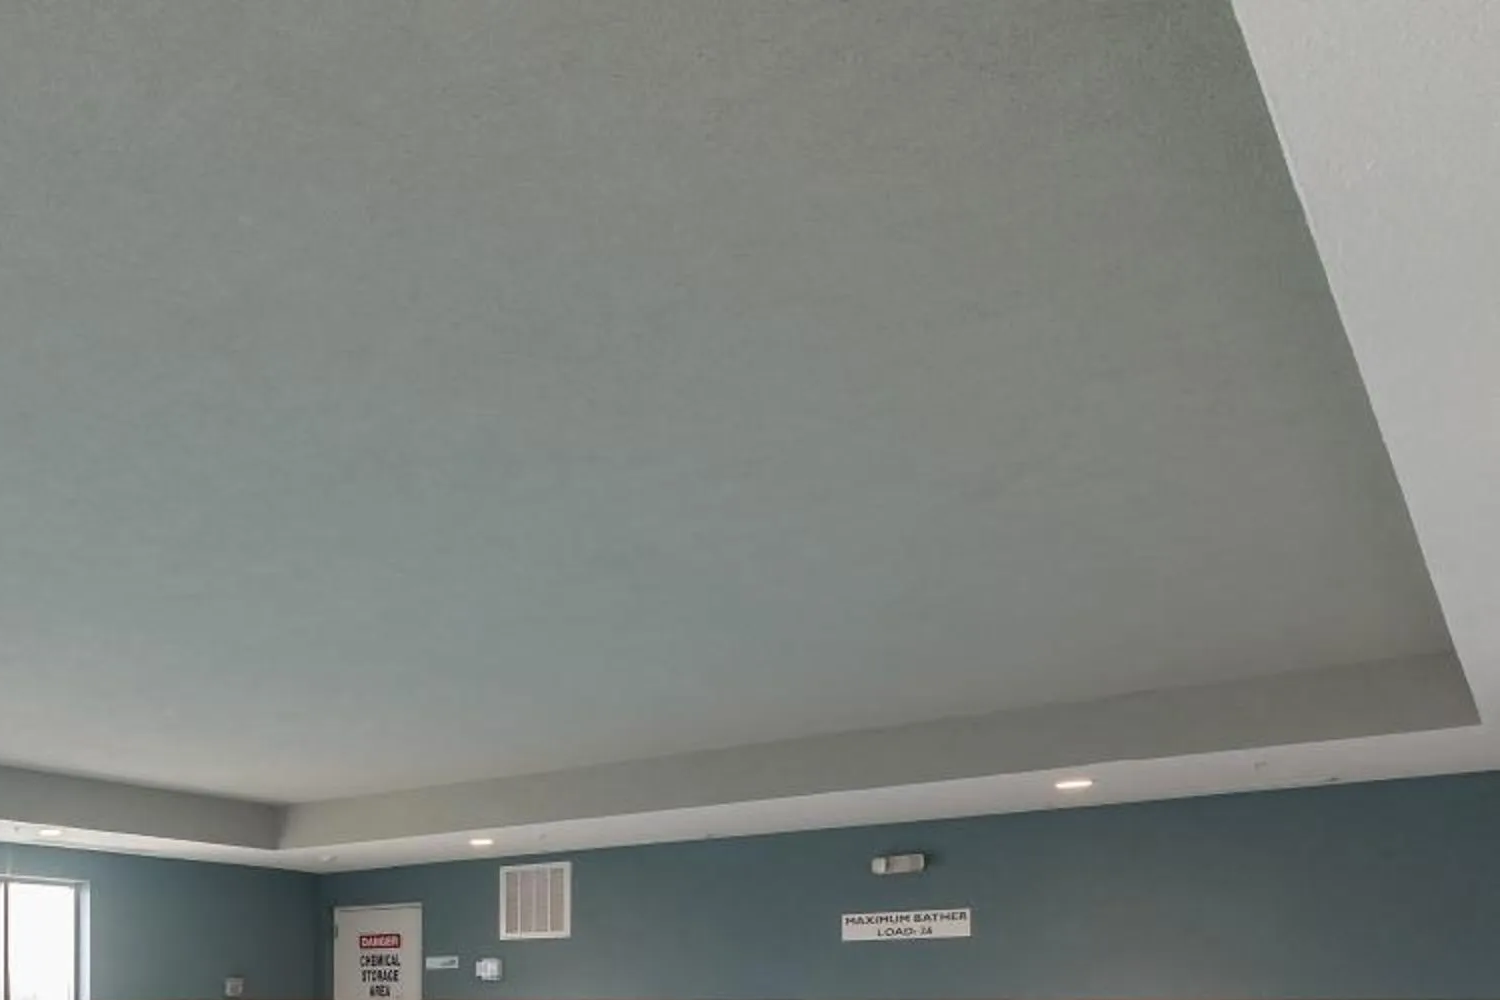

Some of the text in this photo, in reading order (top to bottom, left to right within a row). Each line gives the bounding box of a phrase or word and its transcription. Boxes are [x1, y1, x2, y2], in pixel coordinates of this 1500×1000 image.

[844, 911, 967, 926] MAXIMUM BATHER
[361, 934, 399, 947] DANGER
[360, 953, 401, 967] CHEMICAL
[362, 969, 399, 982] STORAGE
[370, 985, 391, 997] AREA
